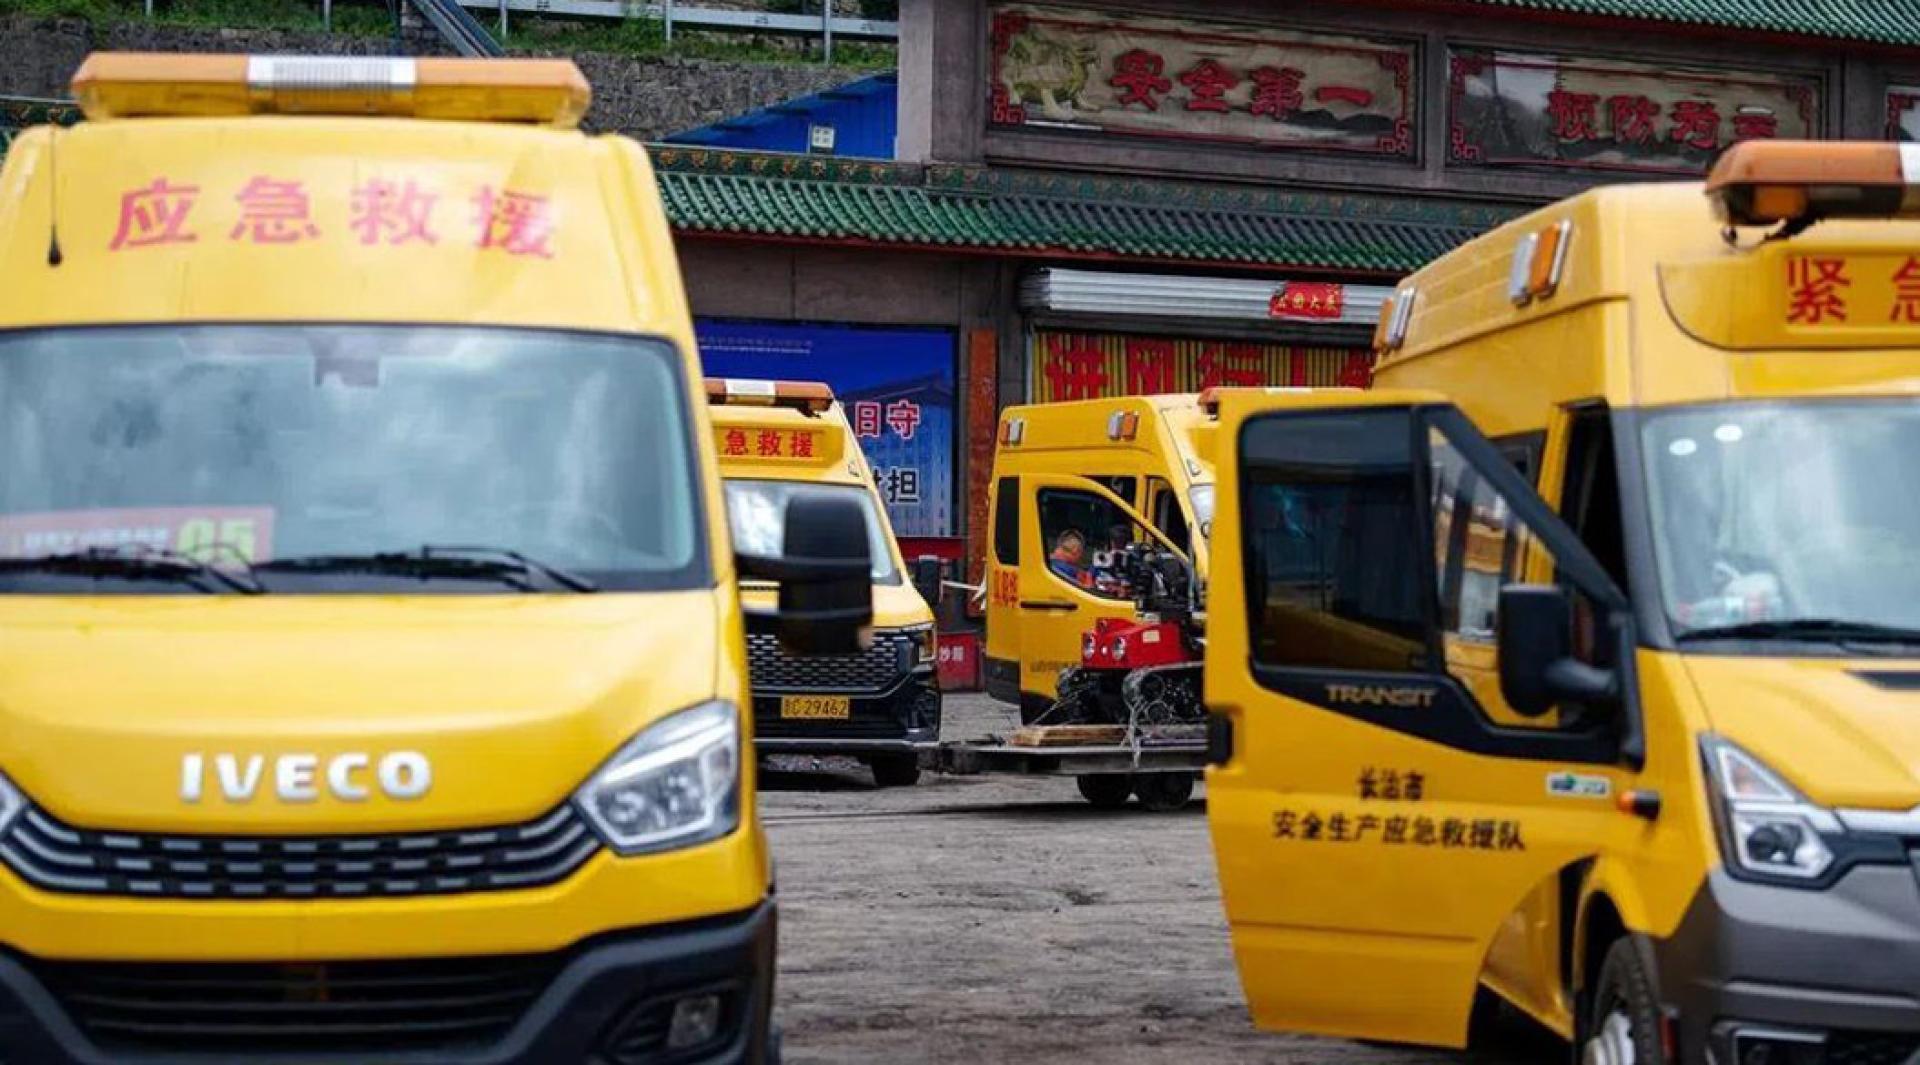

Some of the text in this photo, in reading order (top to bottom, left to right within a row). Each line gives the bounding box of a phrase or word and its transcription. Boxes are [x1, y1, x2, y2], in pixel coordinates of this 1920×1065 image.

[1108, 49, 1375, 120] 安全第一
[107, 175, 557, 260] 应急救援
[855, 399, 921, 440] 日守
[725, 427, 813, 457] 急救援
[1326, 684, 1438, 708] TRANSIT
[180, 751, 433, 803] IVECO
[1357, 767, 1425, 801] 长治市
[1273, 809, 1527, 850] 安全生产应急救援队
